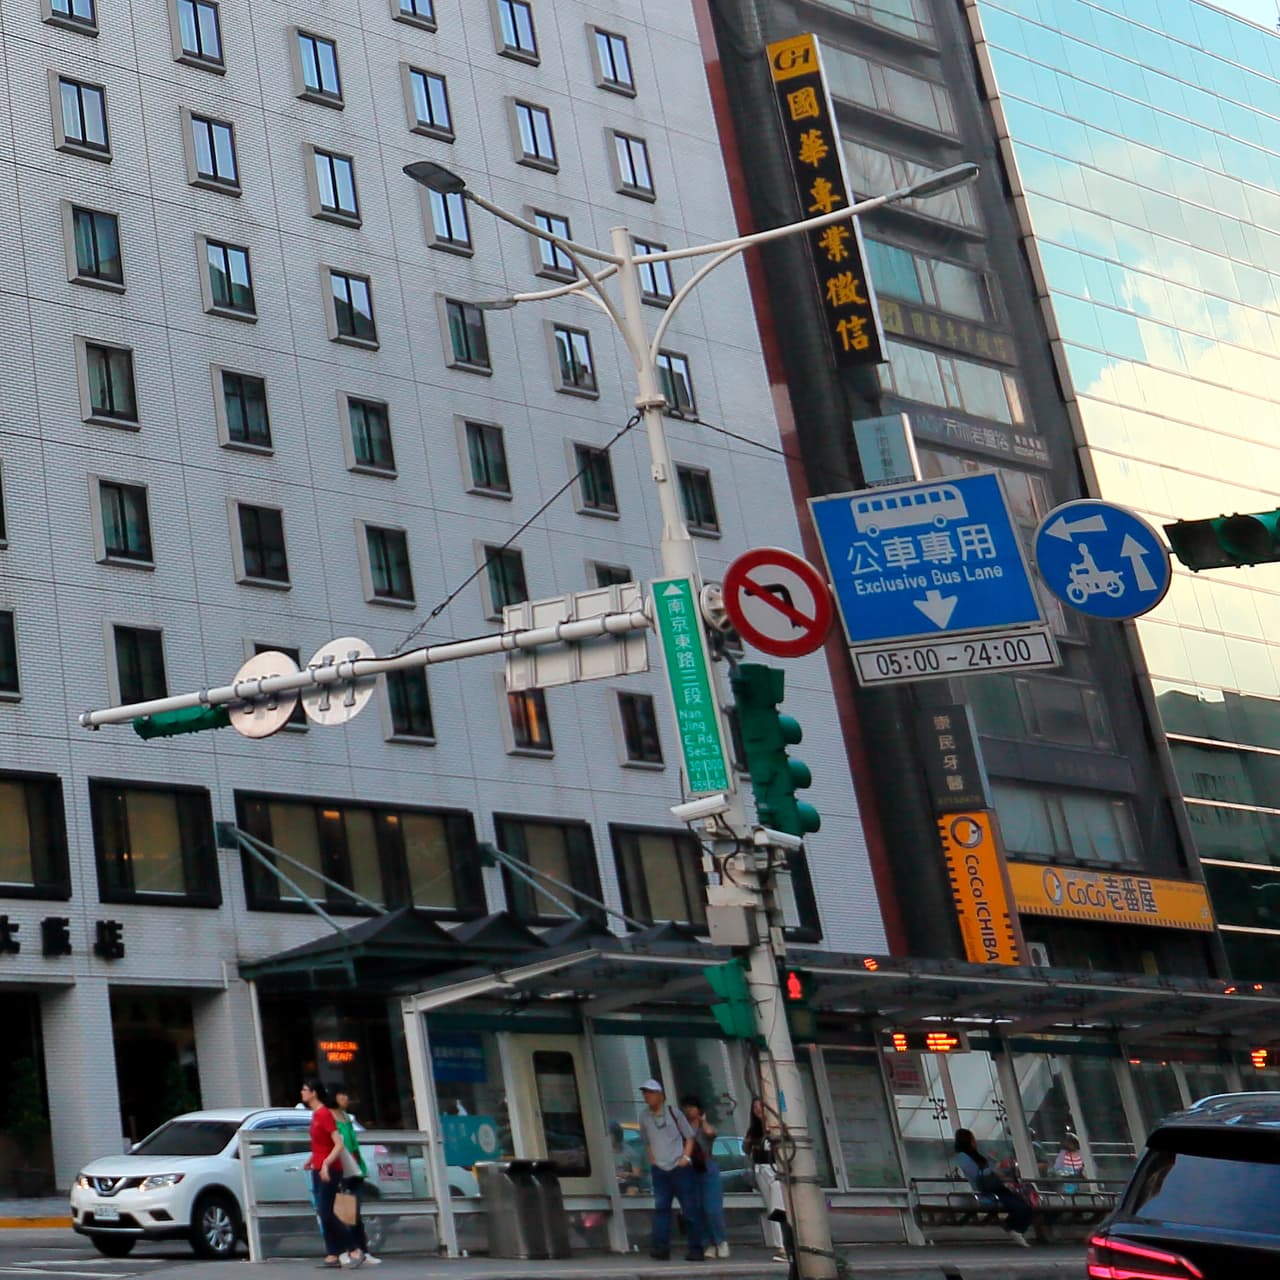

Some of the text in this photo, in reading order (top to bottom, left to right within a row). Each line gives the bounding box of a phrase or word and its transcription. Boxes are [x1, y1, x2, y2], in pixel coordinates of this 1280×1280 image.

[847, 522, 997, 576] 公車專用
[853, 564, 1004, 596] Exclusive Bus Lane
[666, 597, 703, 705] 南京東路三段
[875, 647, 940, 676] 05:00
[963, 638, 1032, 667] 24:00
[965, 854, 984, 900] CoCo
